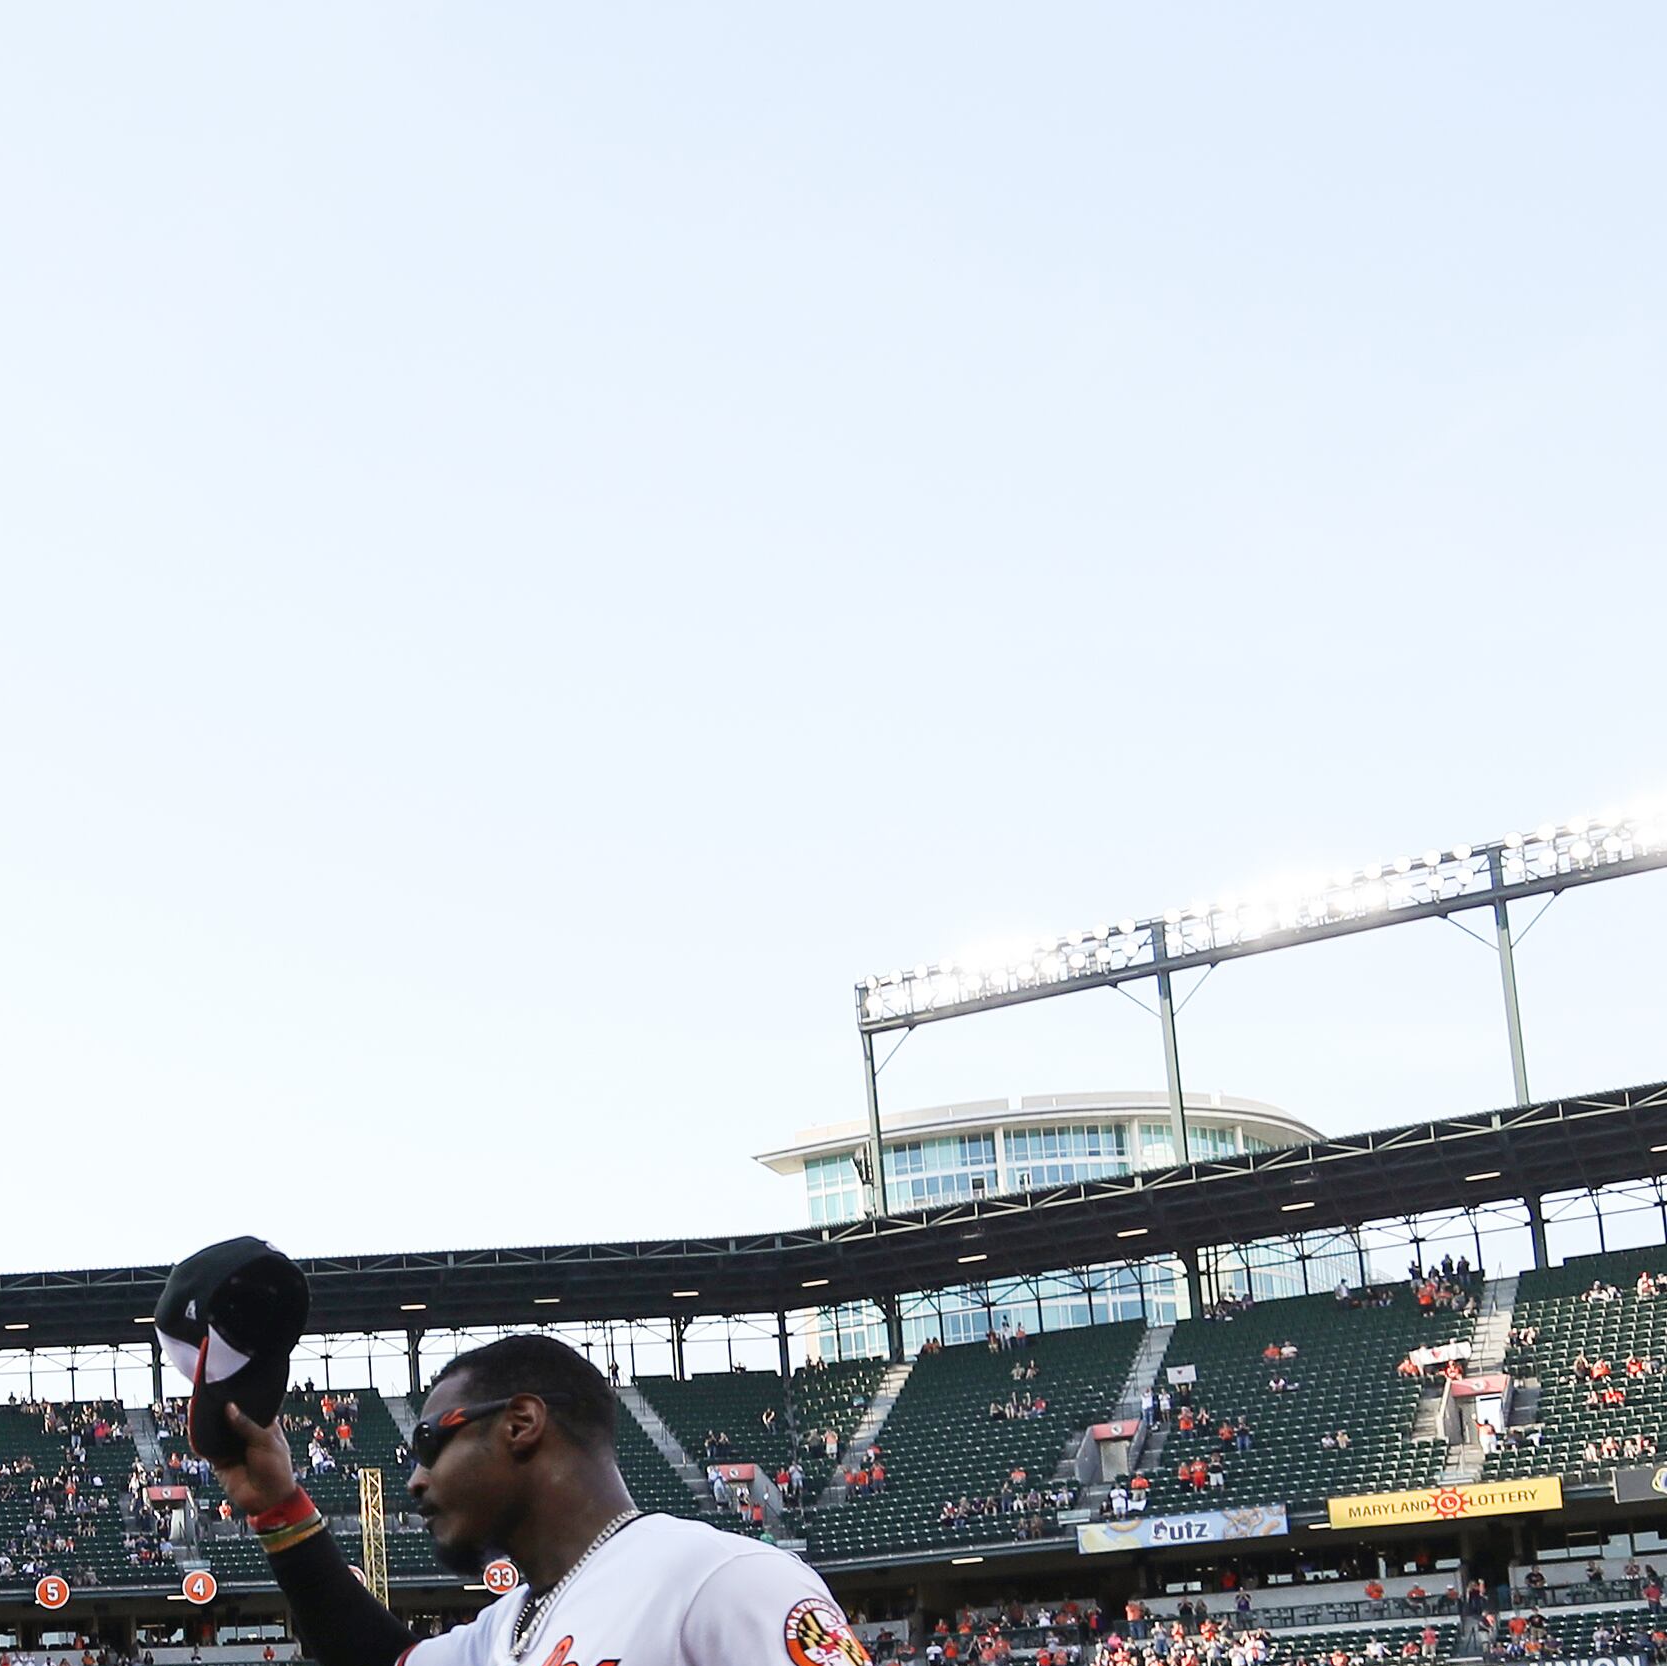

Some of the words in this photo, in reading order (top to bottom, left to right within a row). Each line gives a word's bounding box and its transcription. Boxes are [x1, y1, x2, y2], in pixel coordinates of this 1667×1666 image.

[1348, 1500, 1430, 1518] MARYLAND
[1469, 1489, 1539, 1508] LOTTERY
[489, 1568, 514, 1587] 33
[47, 1583, 59, 1601] 5
[192, 1579, 206, 1596] 4
